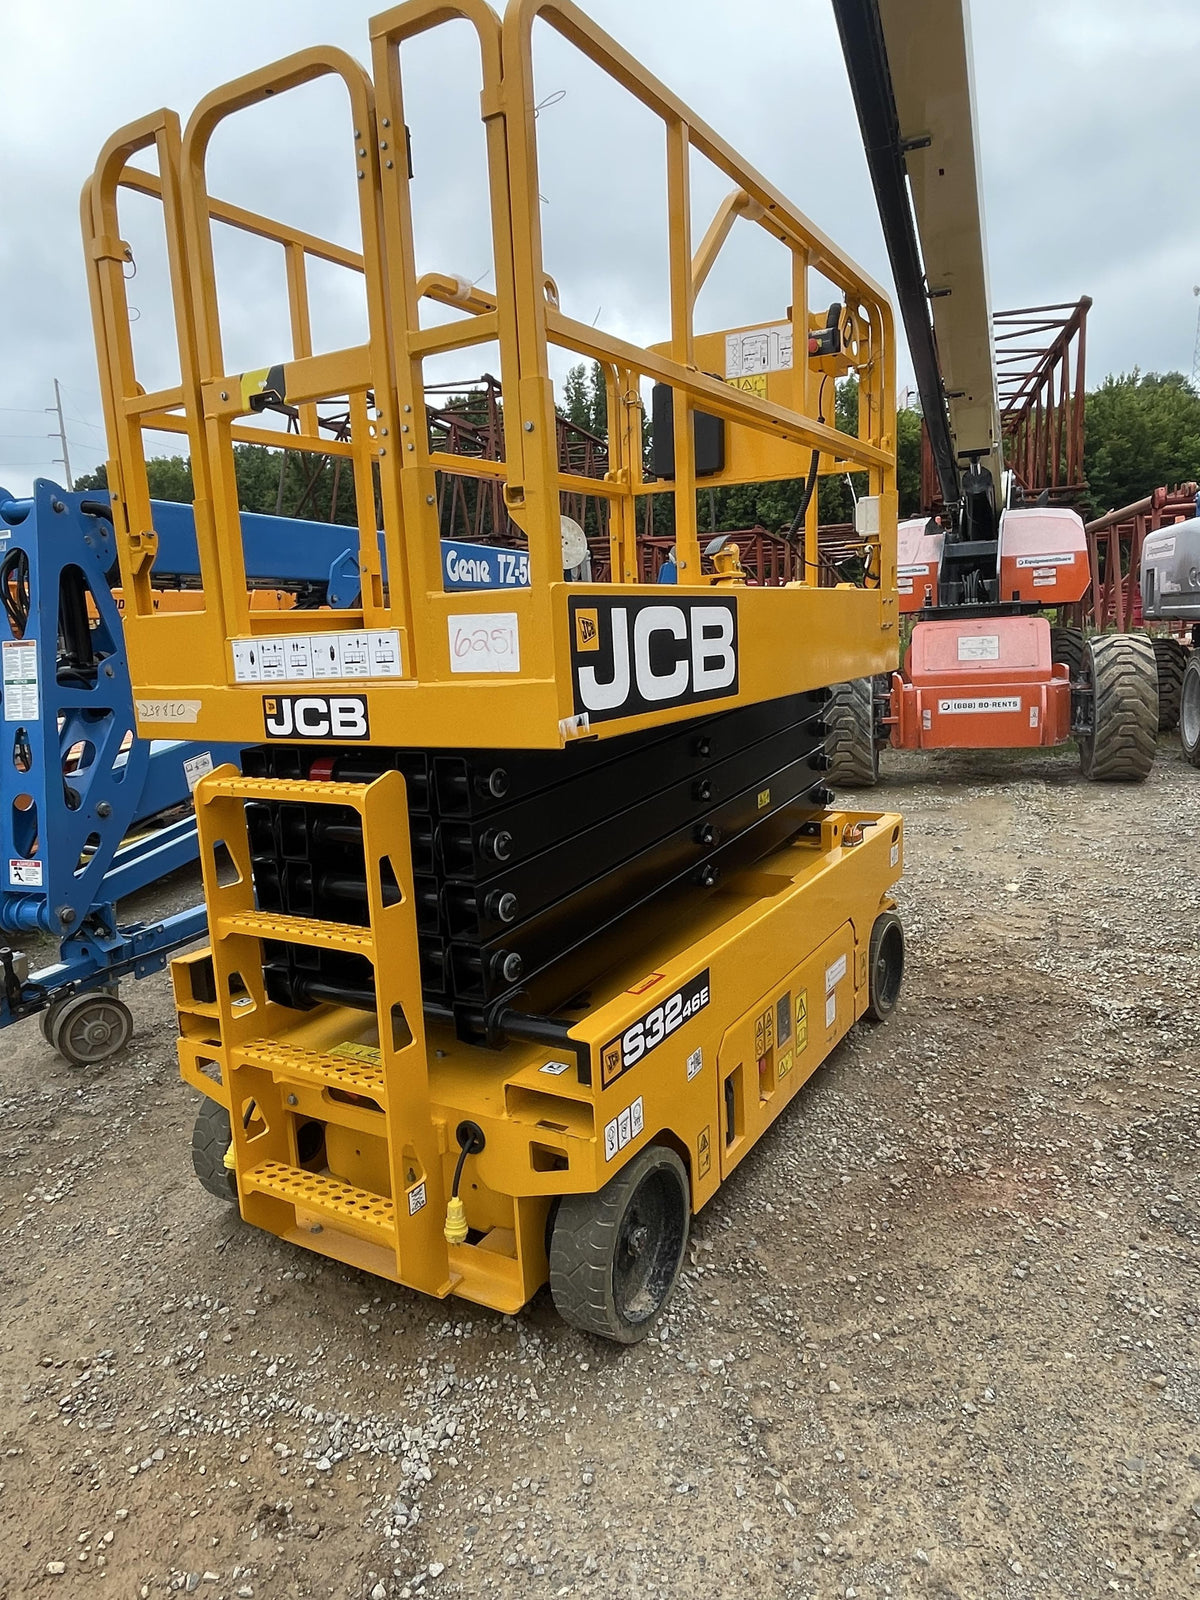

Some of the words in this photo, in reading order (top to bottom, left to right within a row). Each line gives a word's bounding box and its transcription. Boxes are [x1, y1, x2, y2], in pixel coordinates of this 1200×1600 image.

[446, 550, 490, 582] Genie
[454, 628, 514, 657] 6251
[578, 606, 736, 711] JCB
[267, 698, 367, 736] JCB
